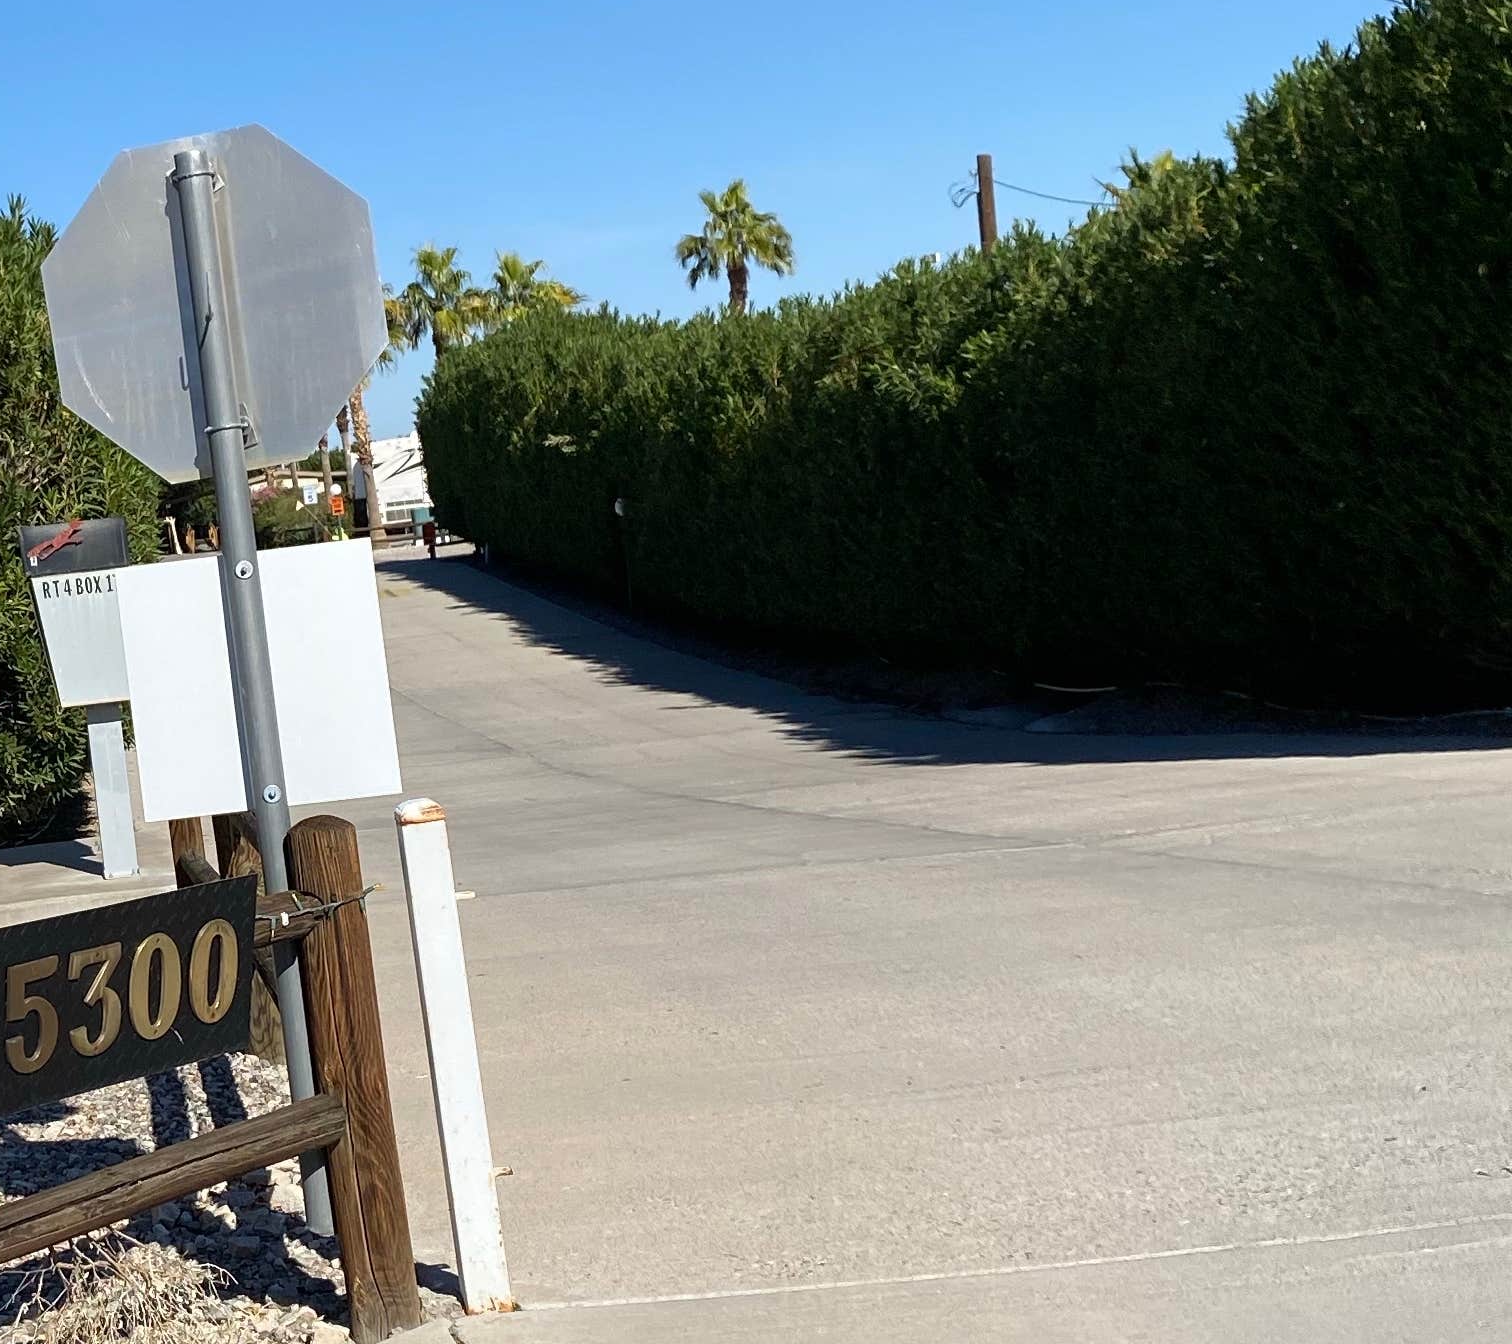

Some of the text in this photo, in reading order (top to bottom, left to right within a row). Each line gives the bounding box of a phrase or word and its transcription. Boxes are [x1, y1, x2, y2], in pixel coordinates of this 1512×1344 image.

[42, 580, 60, 599] RT
[63, 578, 72, 596] 4
[75, 575, 102, 595] BOX
[5, 918, 238, 1075] 5300
